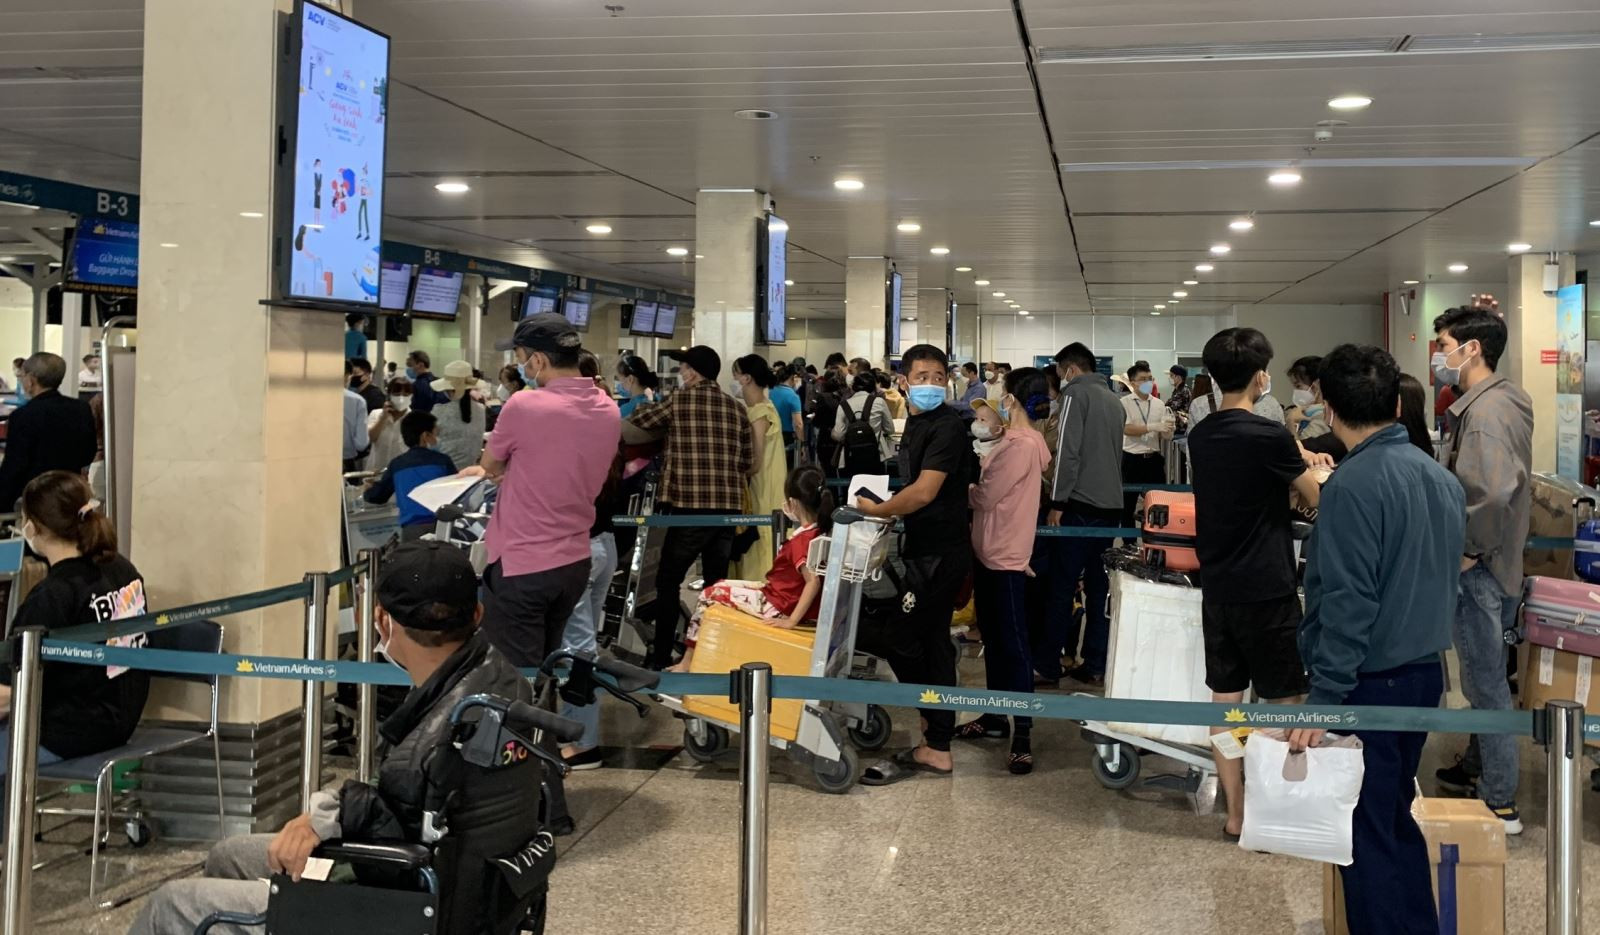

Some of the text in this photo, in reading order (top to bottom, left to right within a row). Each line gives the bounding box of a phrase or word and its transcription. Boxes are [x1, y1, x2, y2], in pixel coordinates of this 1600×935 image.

[308, 11, 326, 26] ACV
[97, 192, 128, 216] B-3
[424, 249, 440, 266] B-6
